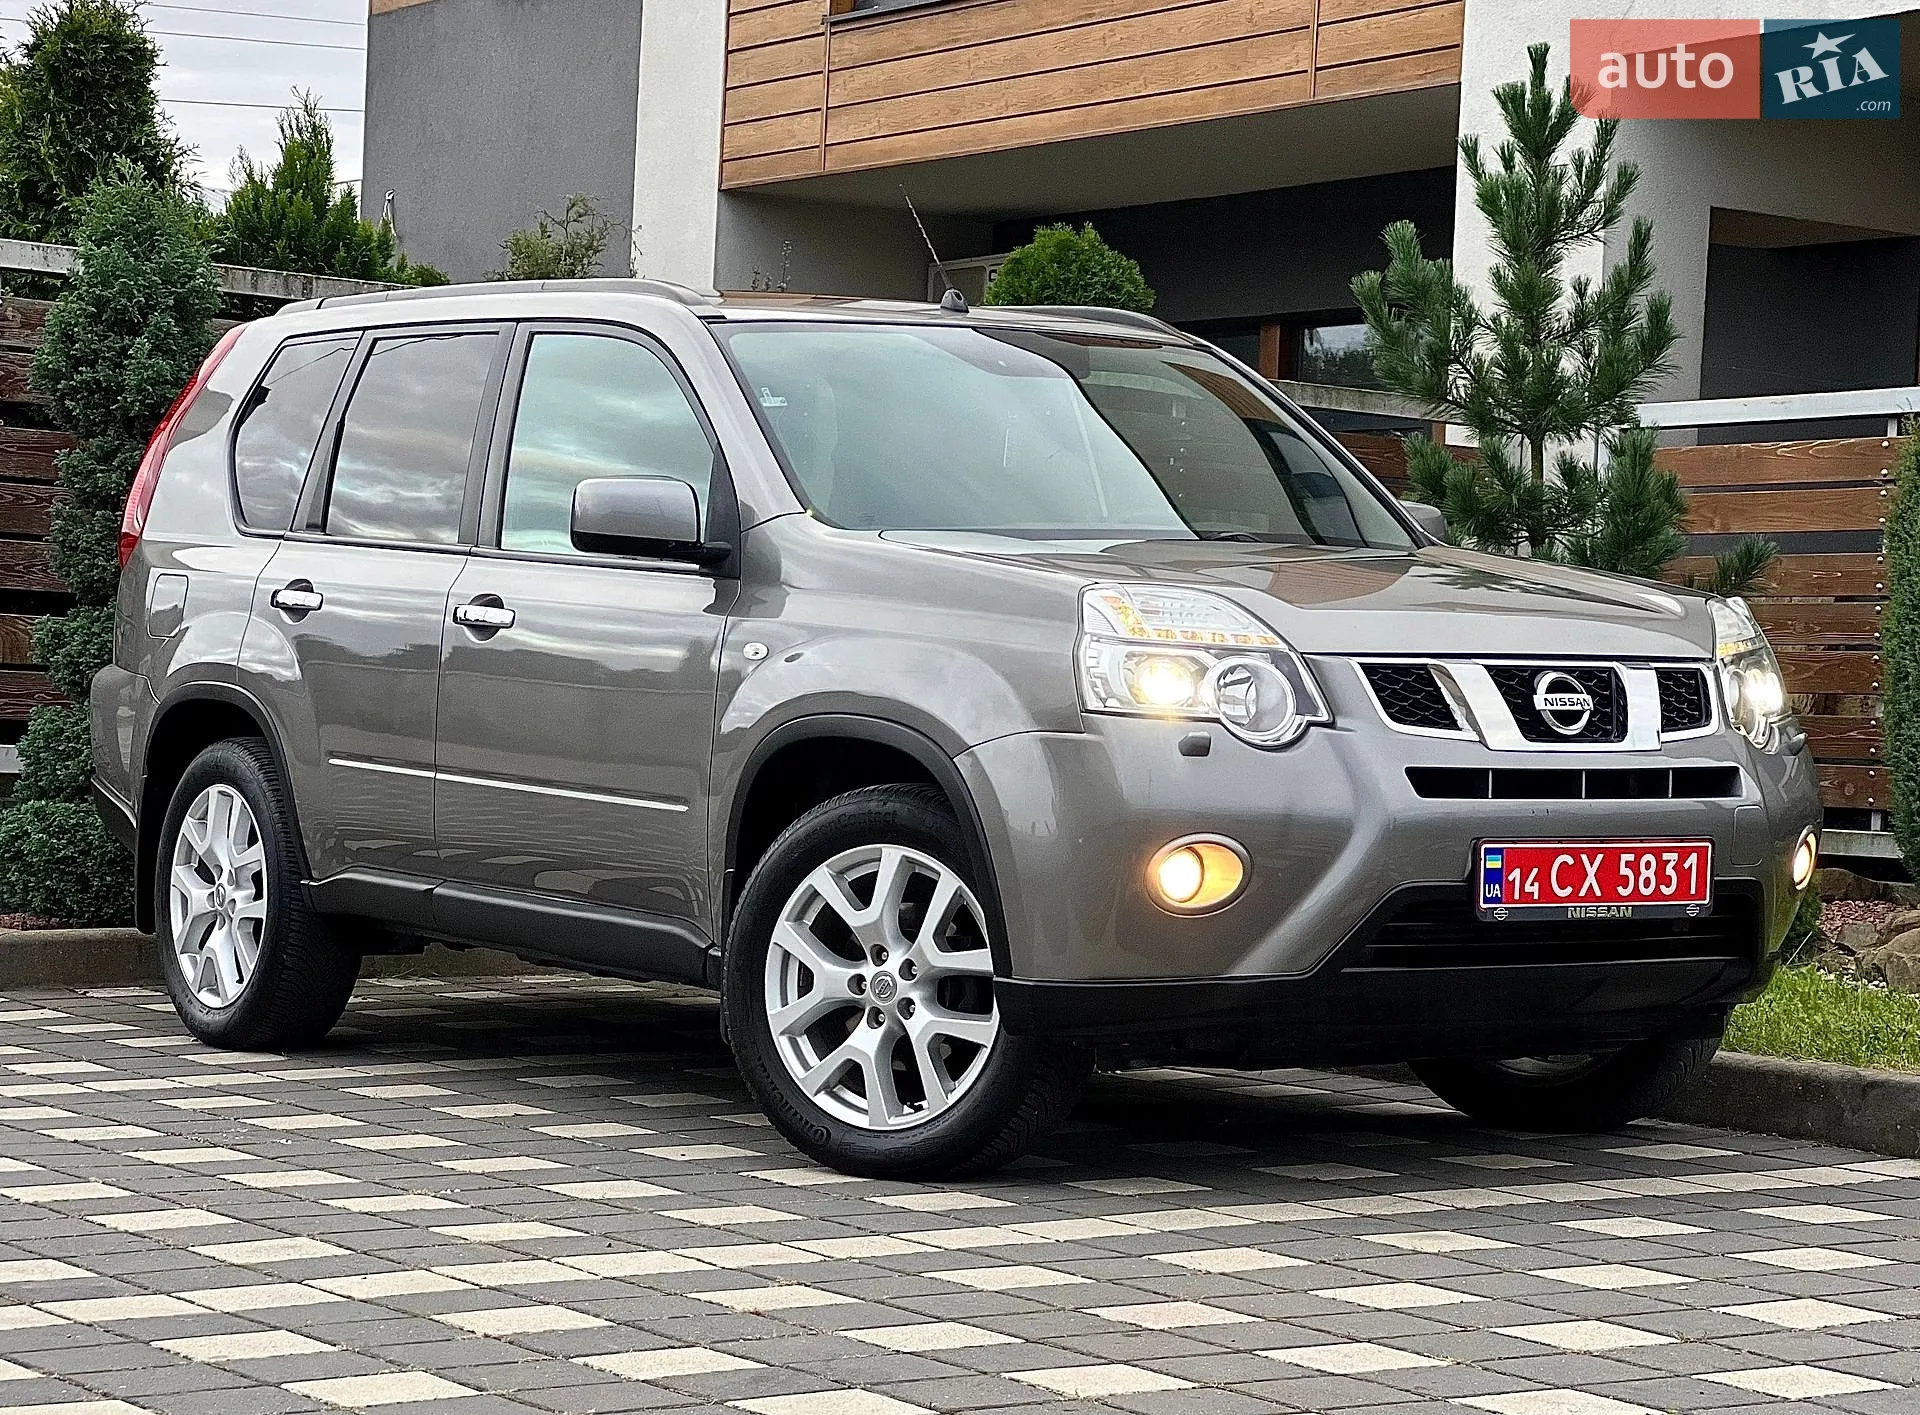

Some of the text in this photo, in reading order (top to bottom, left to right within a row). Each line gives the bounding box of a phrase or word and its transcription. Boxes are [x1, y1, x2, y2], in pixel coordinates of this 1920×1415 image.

[1543, 697, 1591, 707] NISSAN
[1507, 852, 1699, 900] 14 CX 5831
[1485, 884, 1501, 898] UA
[1567, 906, 1633, 919] NISSAN
